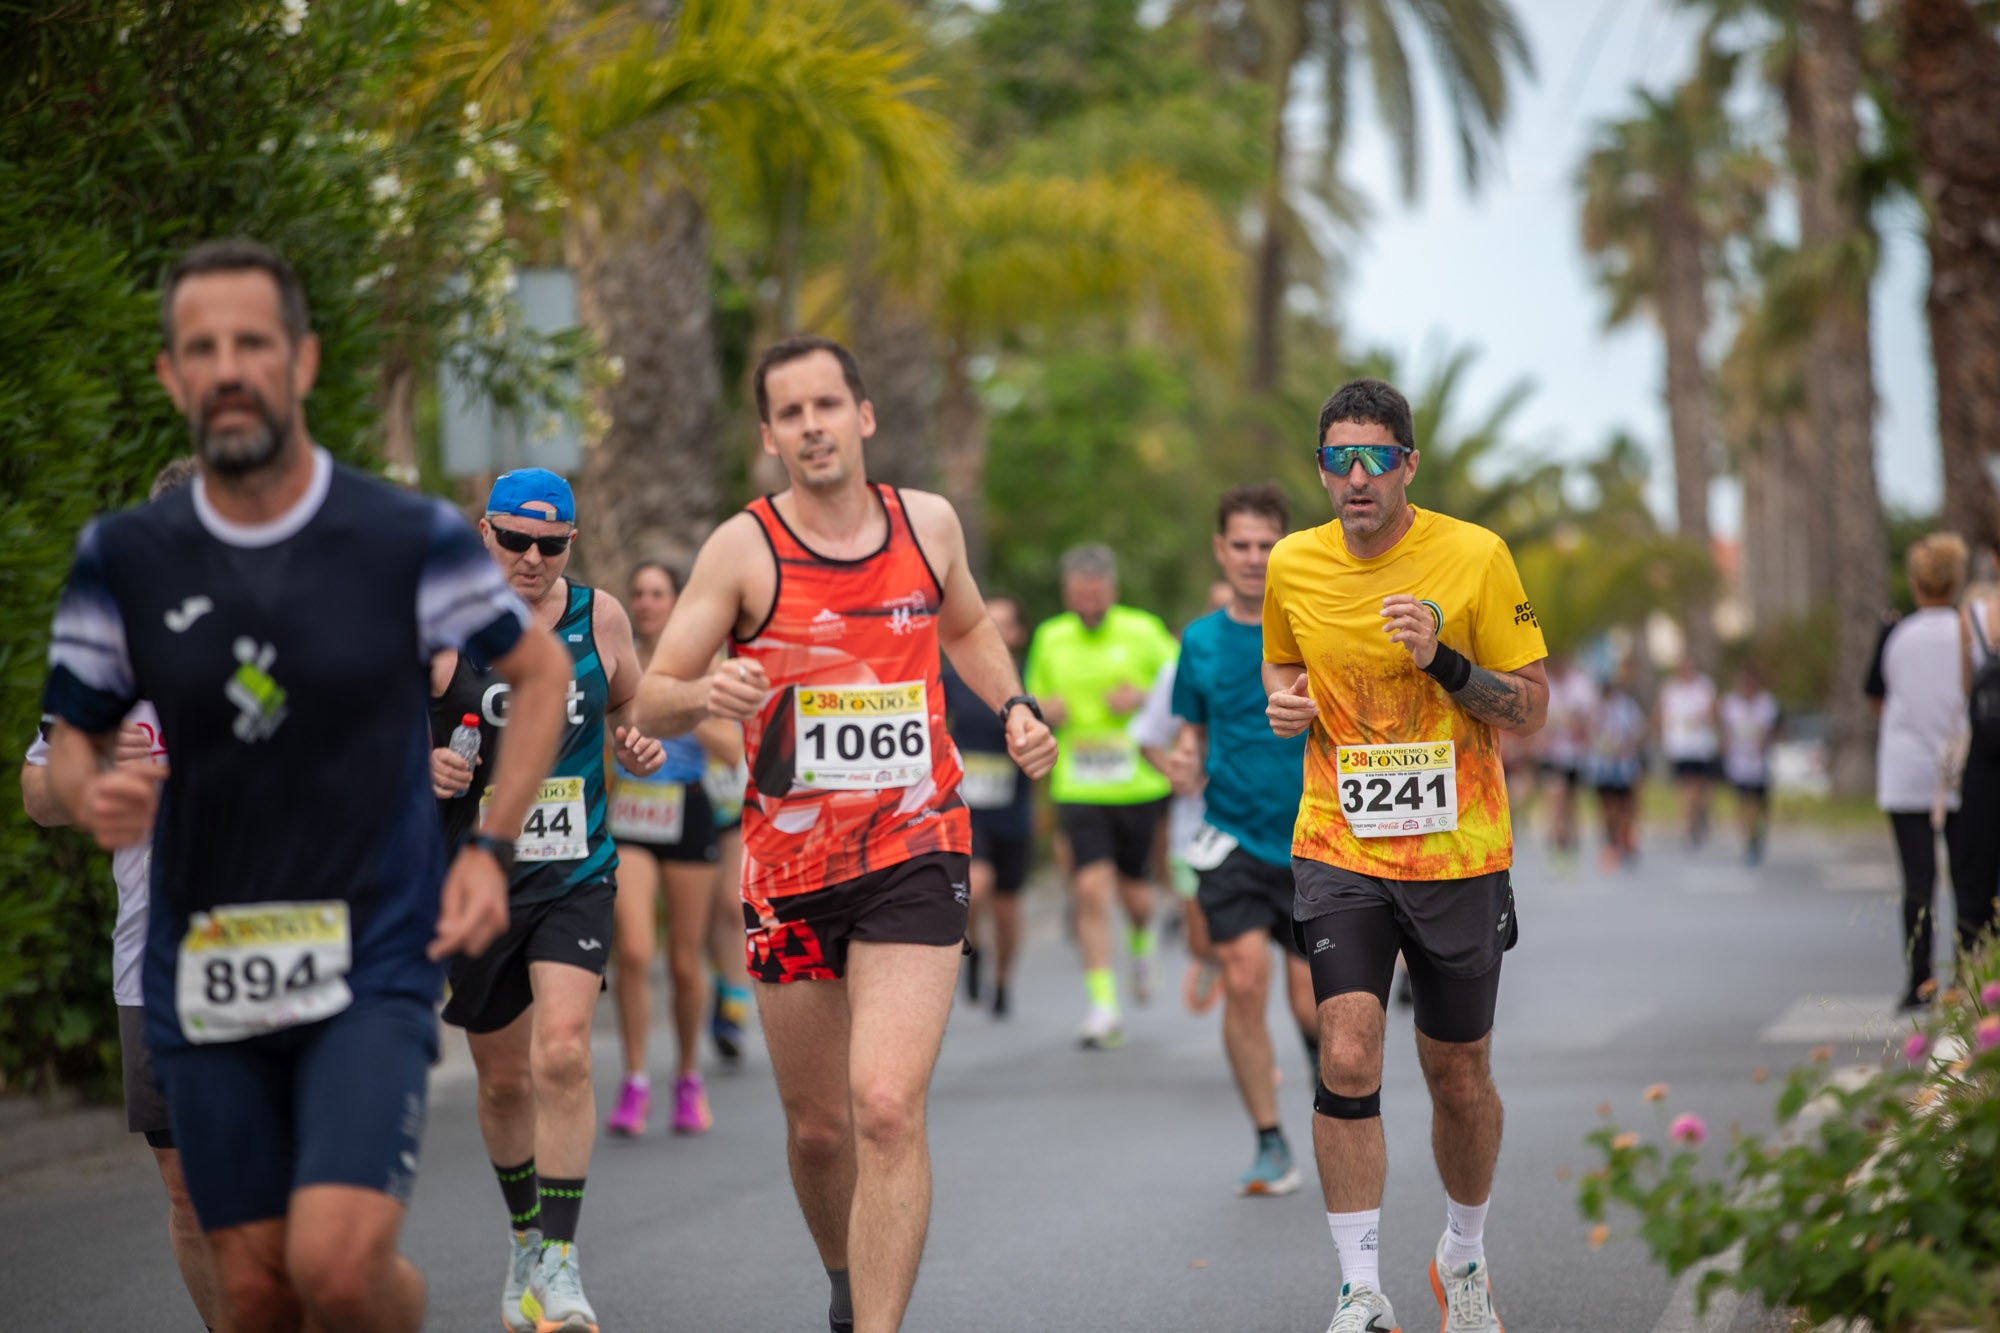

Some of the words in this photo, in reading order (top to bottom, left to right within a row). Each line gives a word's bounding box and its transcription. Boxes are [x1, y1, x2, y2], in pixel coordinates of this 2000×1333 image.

[817, 692, 838, 709] 38
[839, 697, 904, 711] FONDO
[805, 720, 924, 760] 1066
[1351, 751, 1368, 767] 38
[1368, 753, 1429, 767] FONDO
[1341, 774, 1447, 813] 3241
[523, 807, 572, 838] 44
[206, 952, 314, 1004] 894
